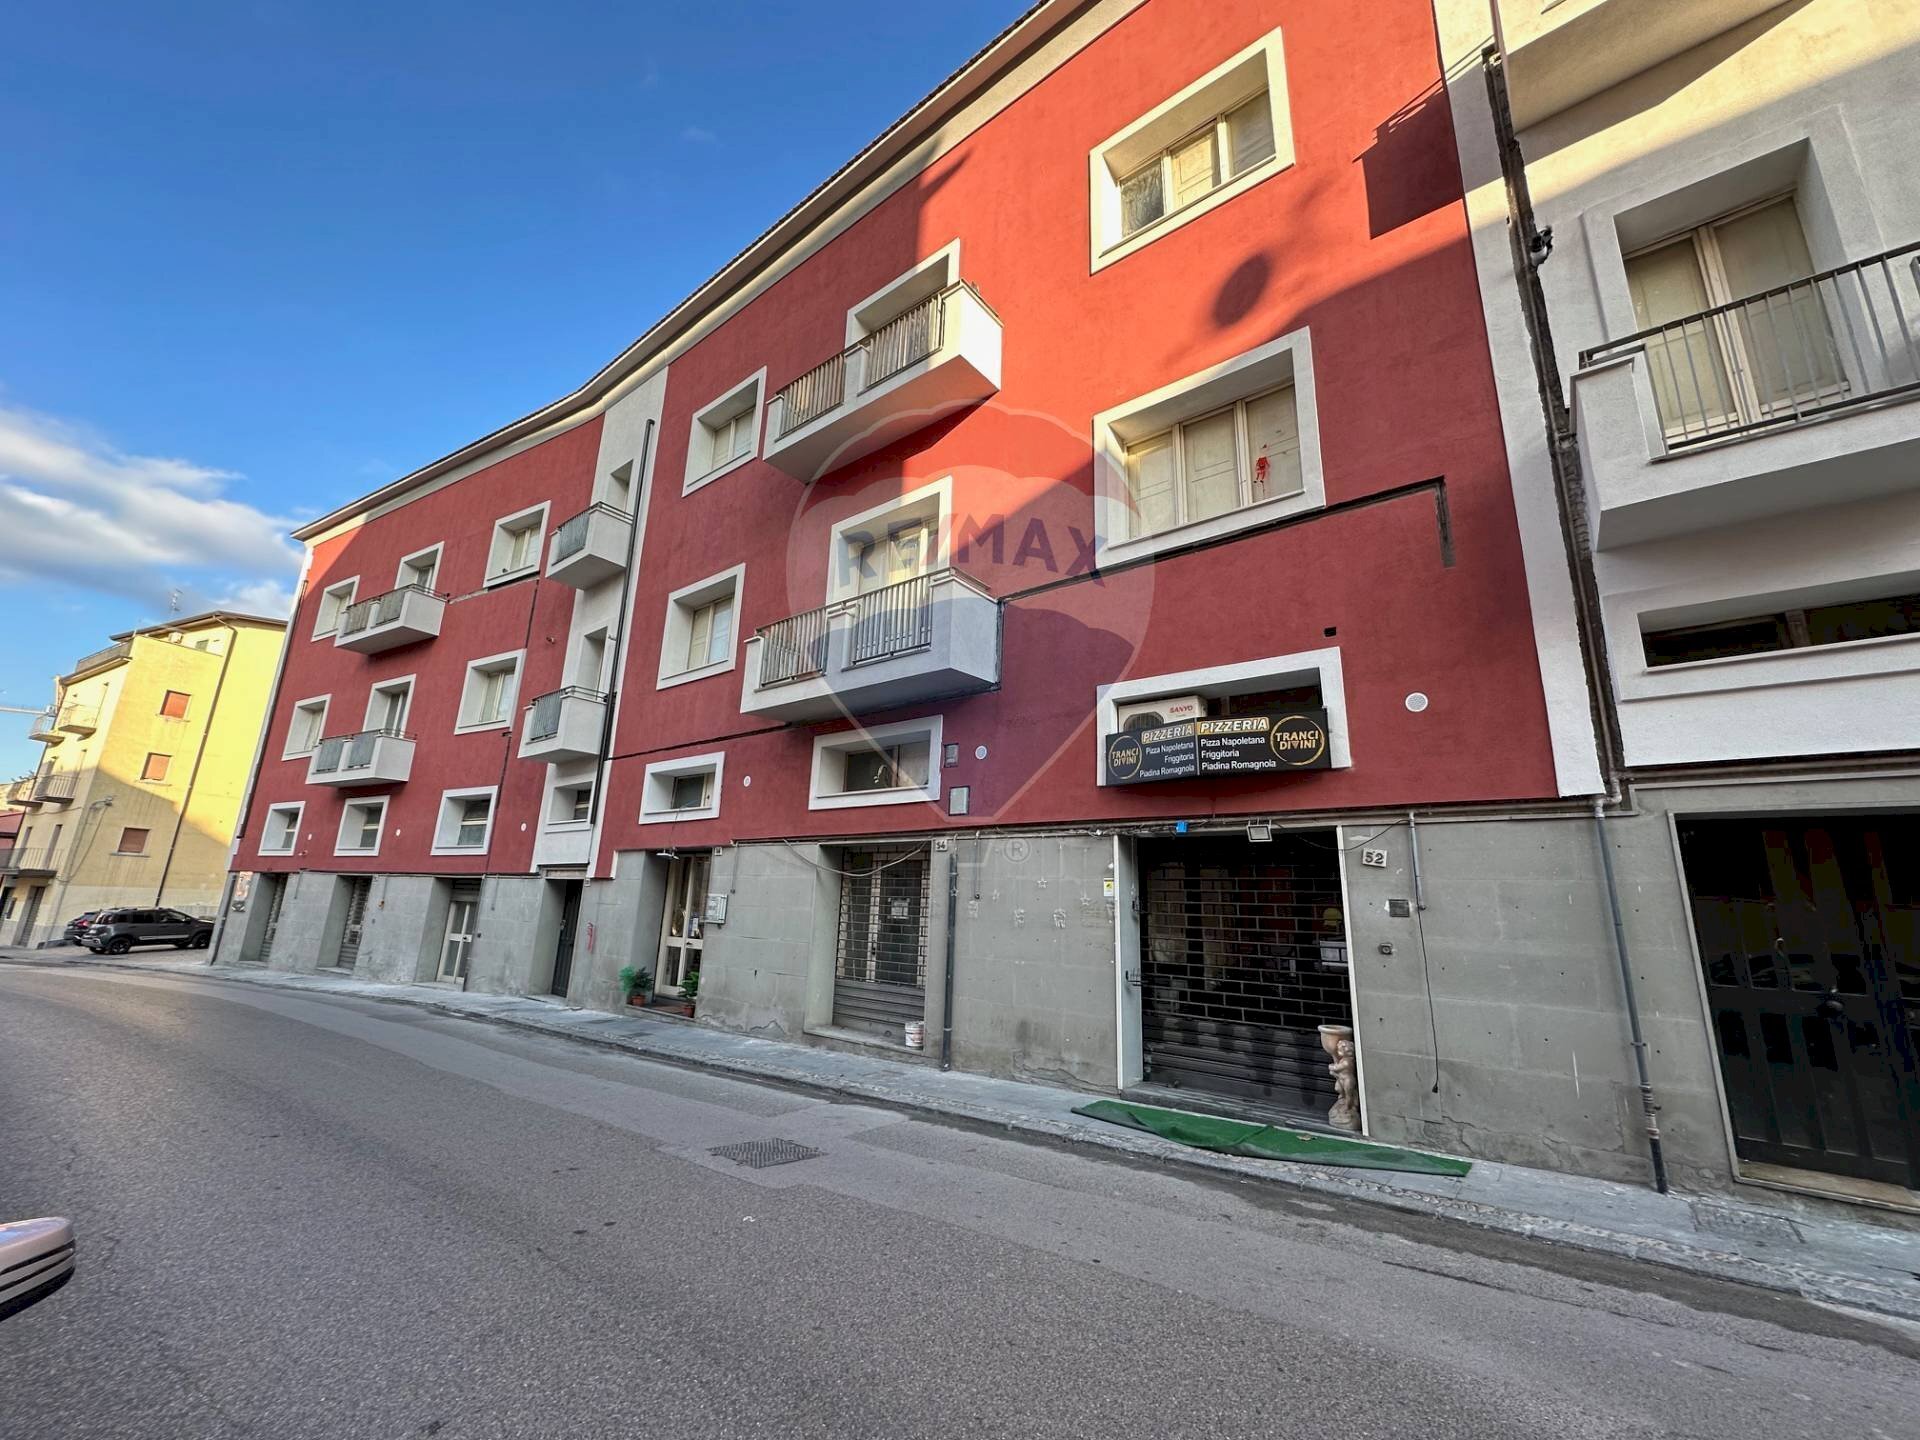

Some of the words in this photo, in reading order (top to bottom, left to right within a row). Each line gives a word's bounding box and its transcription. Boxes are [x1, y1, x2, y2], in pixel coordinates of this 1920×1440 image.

[1169, 705, 1193, 713] SANYO
[1200, 719, 1268, 733] PIZZERIA
[1143, 724, 1192, 743] PIZZERIA
[1275, 730, 1319, 741] TRANCI
[1200, 738, 1220, 747] Pizza
[1221, 735, 1266, 747] Napoletana
[1279, 740, 1316, 750] DIVINI
[1112, 747, 1139, 759] TRANCI
[1146, 746, 1160, 755] Pizza
[1161, 741, 1194, 753] Napoletana
[1164, 753, 1195, 764] Friggitoria
[1201, 749, 1240, 760] Friggitoria
[1113, 755, 1137, 767] DIVINI
[1201, 761, 1230, 771] Piadina
[1231, 759, 1277, 771] Romagnola
[1140, 768, 1160, 778] Piadina
[1161, 764, 1195, 775] Romagnola
[1365, 851, 1384, 864] 52
